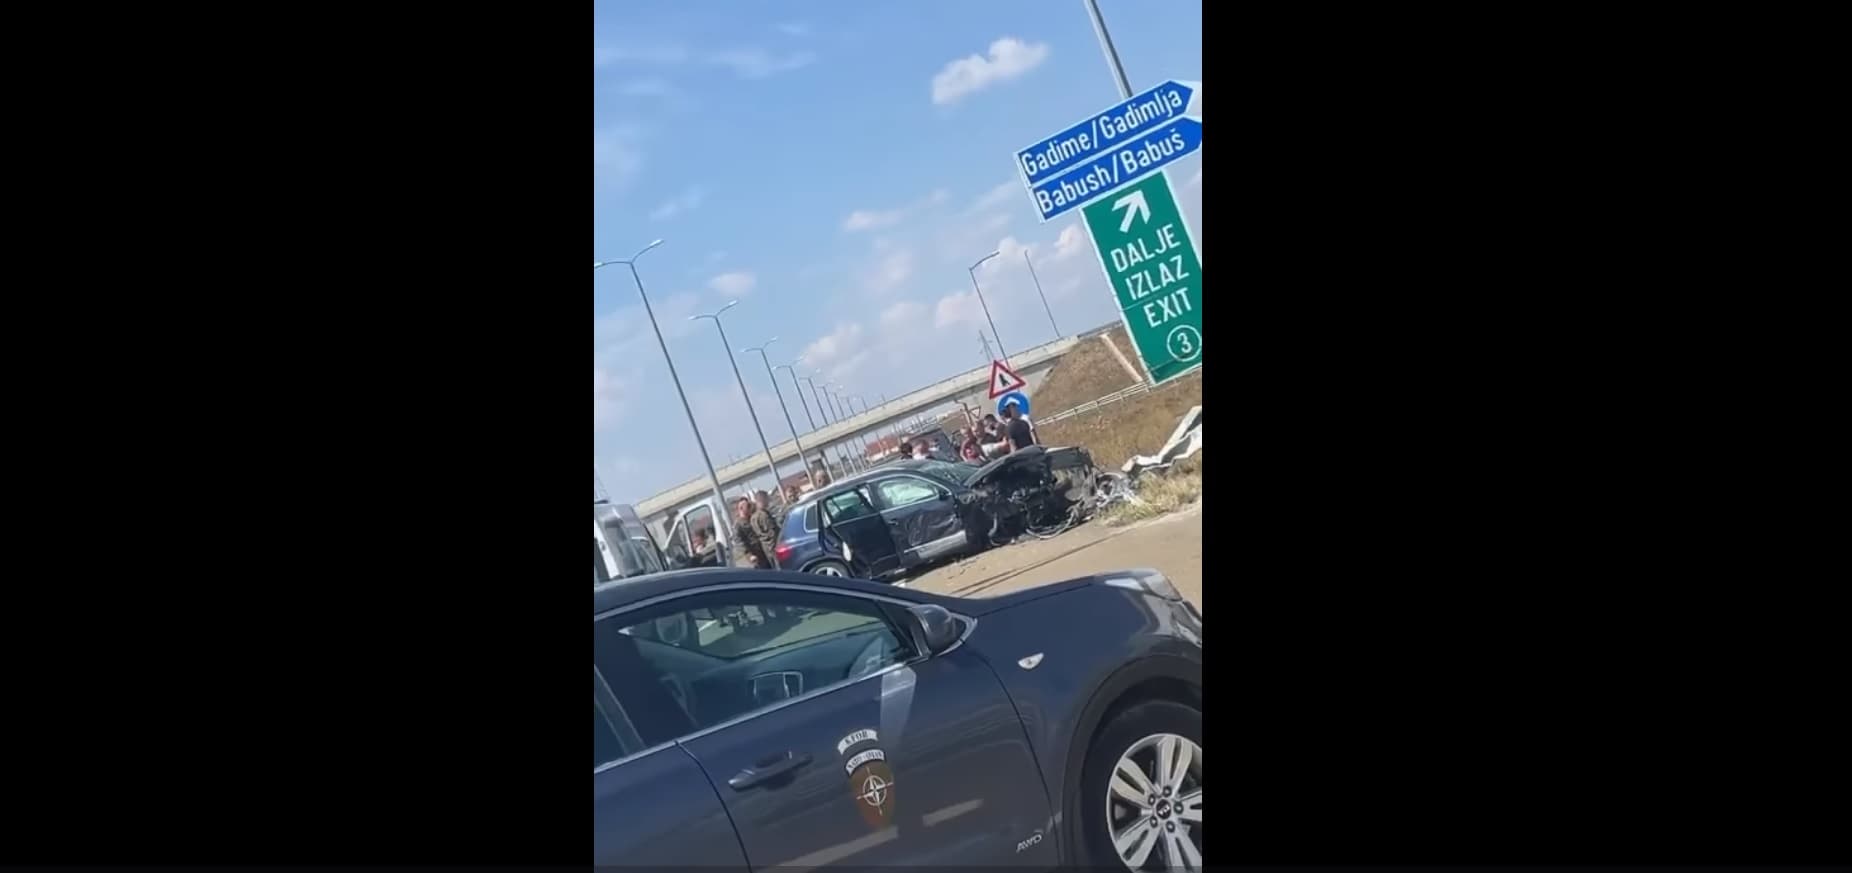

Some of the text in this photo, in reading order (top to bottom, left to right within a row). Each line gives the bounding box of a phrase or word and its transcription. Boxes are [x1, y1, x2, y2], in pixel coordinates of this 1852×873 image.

[1021, 89, 1183, 176] Gadime/Gadimlja
[1036, 128, 1185, 213] Babush/Babuš
[1110, 223, 1181, 273] DALJE
[1125, 254, 1190, 300] IZLAZ
[1143, 287, 1192, 328] EXIT
[1177, 332, 1193, 354] 3
